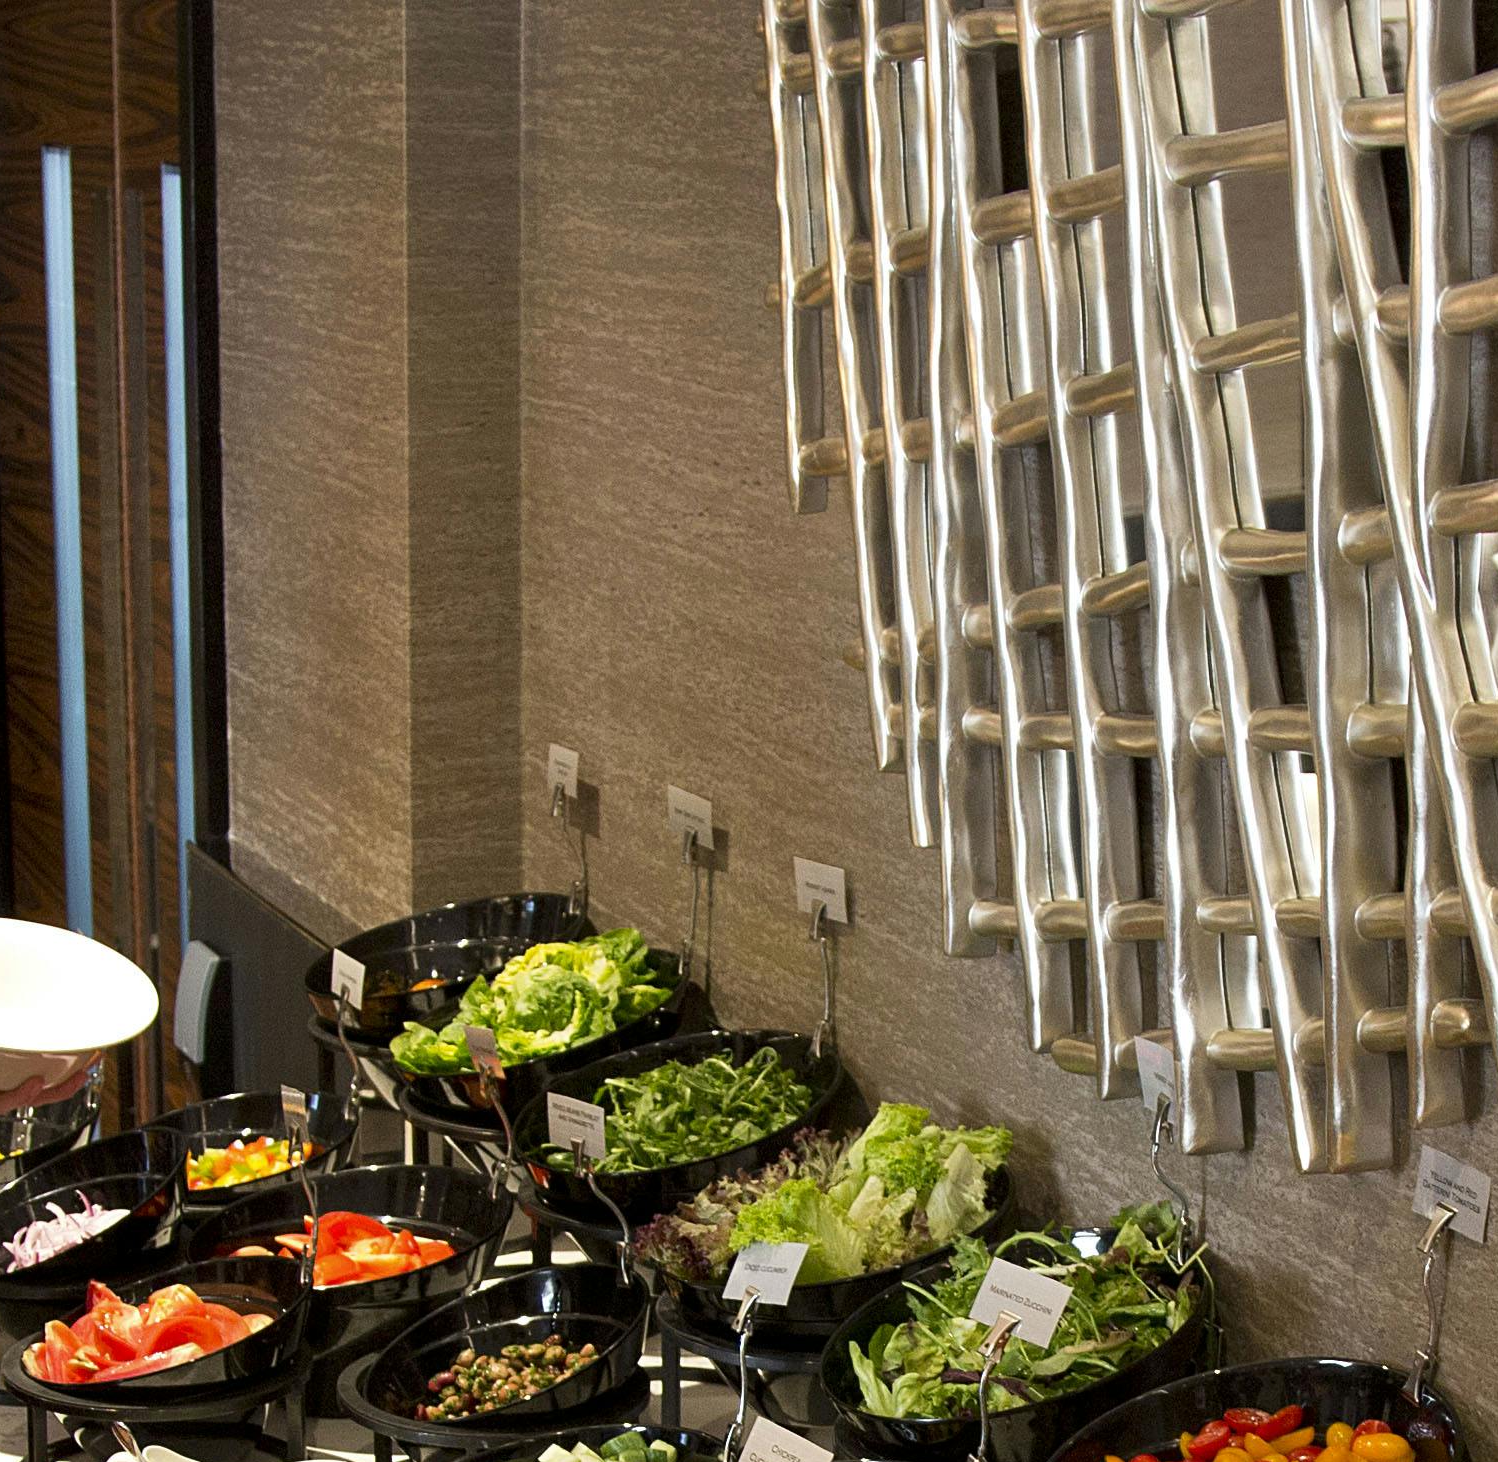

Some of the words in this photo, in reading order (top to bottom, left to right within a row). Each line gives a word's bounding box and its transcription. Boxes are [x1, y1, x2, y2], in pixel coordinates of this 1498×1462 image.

[1430, 1170, 1452, 1187] YELLOW
[1465, 1186, 1478, 1200] RED
[990, 1284, 1024, 1304] MARINATED
[1023, 1297, 1053, 1315] ZUCCHINI
